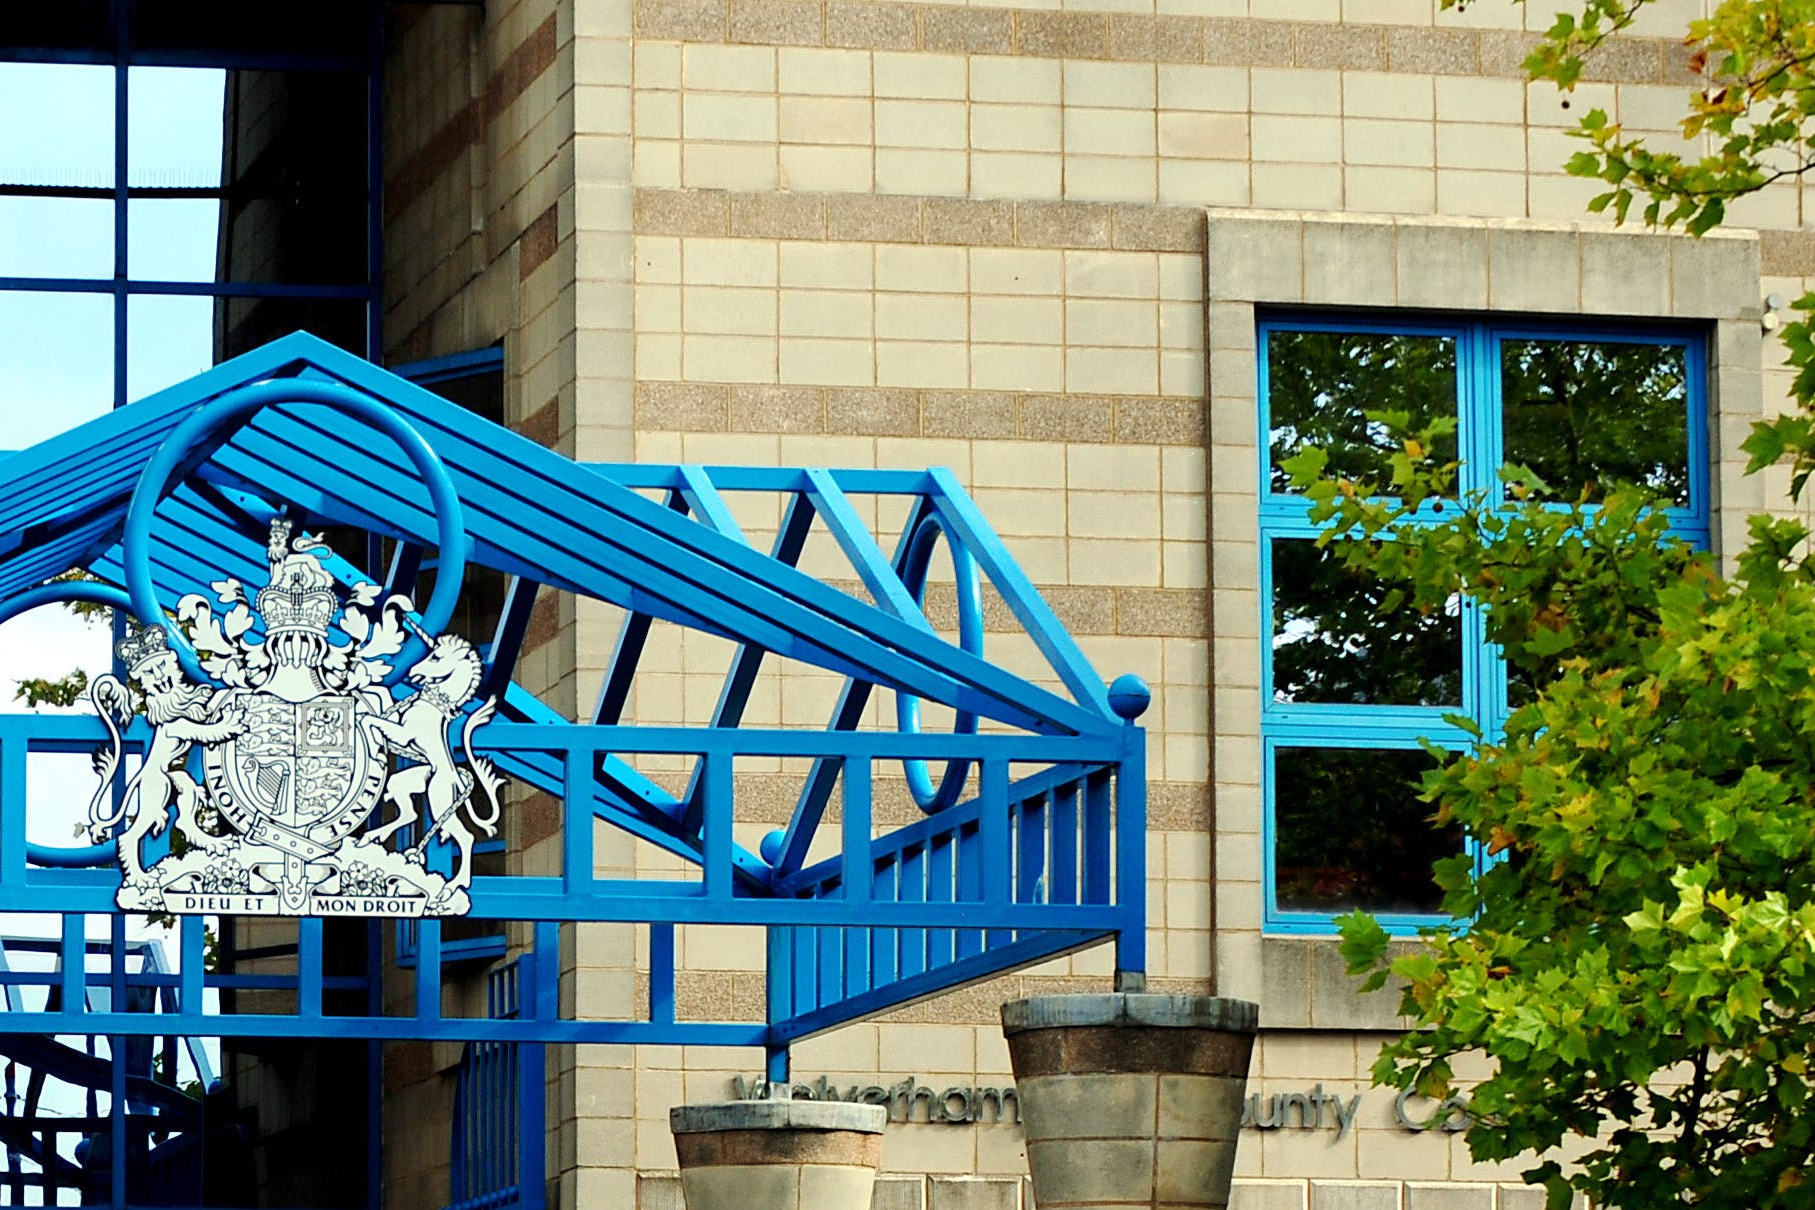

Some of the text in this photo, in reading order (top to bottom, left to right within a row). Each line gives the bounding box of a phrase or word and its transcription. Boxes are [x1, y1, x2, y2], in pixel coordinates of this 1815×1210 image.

[208, 765, 247, 824] HONI
[328, 775, 381, 839] PENSE
[185, 897, 416, 913] DIEU ET MON DROIT
